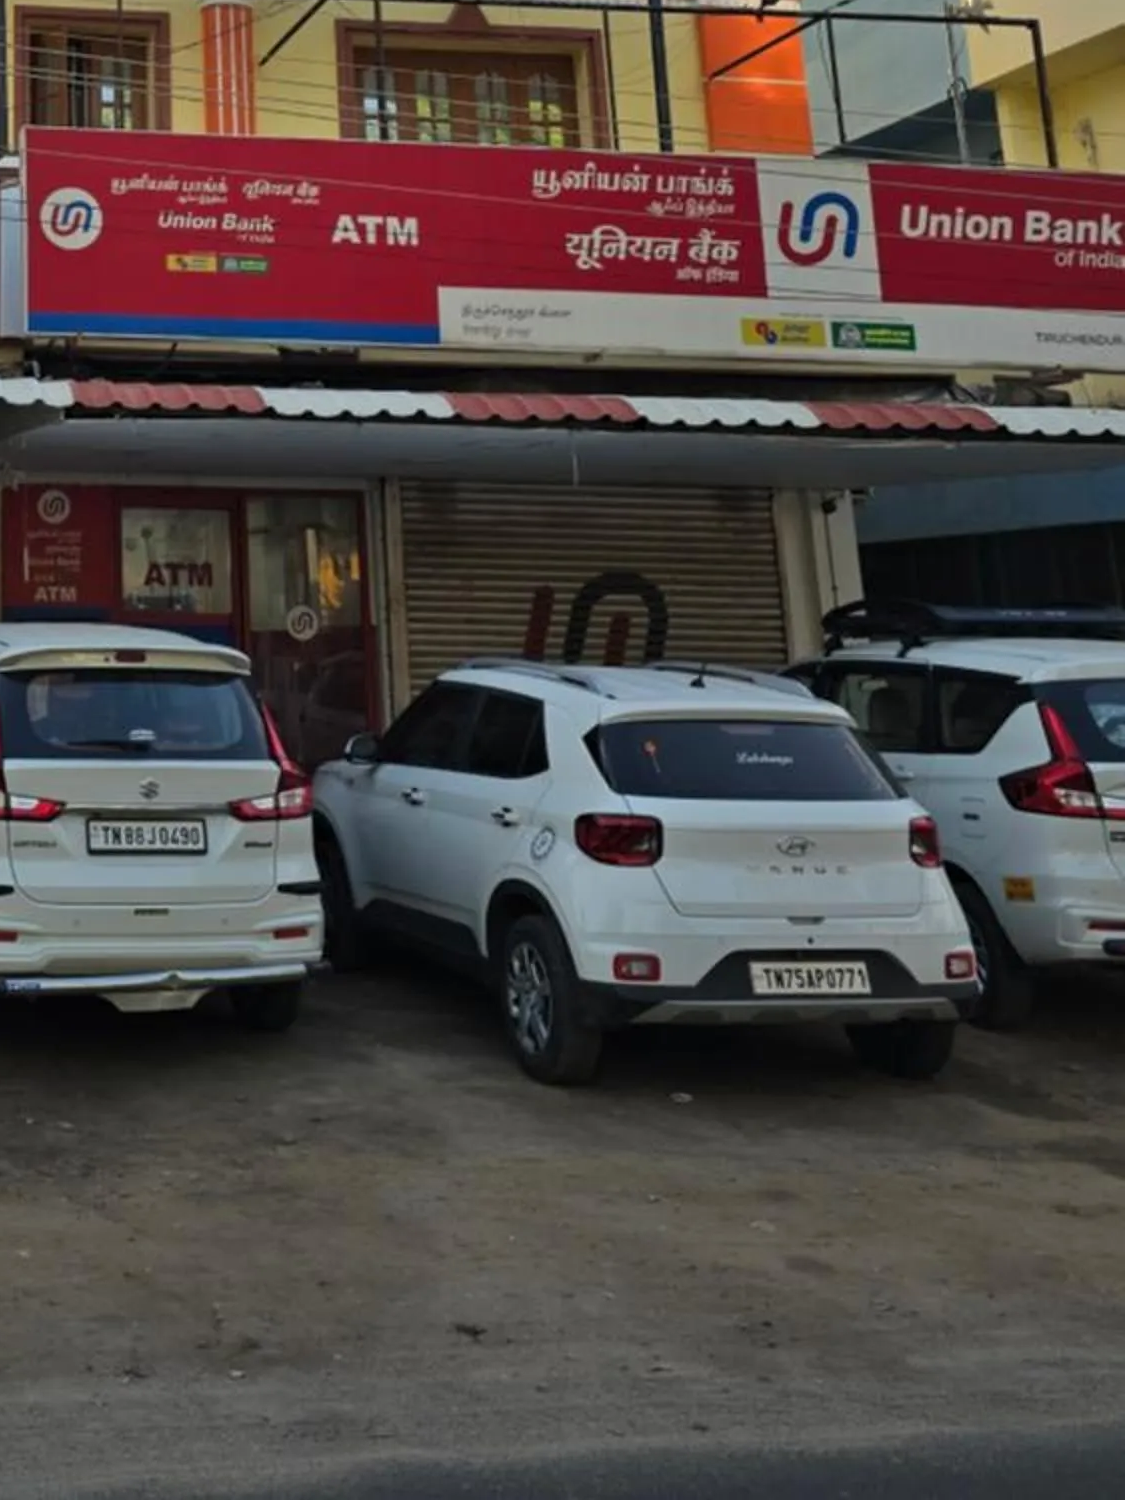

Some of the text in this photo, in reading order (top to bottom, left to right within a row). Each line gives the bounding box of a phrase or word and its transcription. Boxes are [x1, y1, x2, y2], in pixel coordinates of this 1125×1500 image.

[532, 160, 735, 199] யூனியன் பாங்க்
[158, 210, 276, 232] Union Bank
[331, 213, 420, 247] ATM
[900, 204, 1125, 246] Union Bank
[565, 223, 742, 270] यूनियन बैंक
[1054, 250, 1075, 268] of
[144, 561, 214, 588] ATM
[33, 586, 79, 604] ATM
[101, 826, 201, 846] TN88J0490
[762, 967, 868, 990] TN75AP0771
